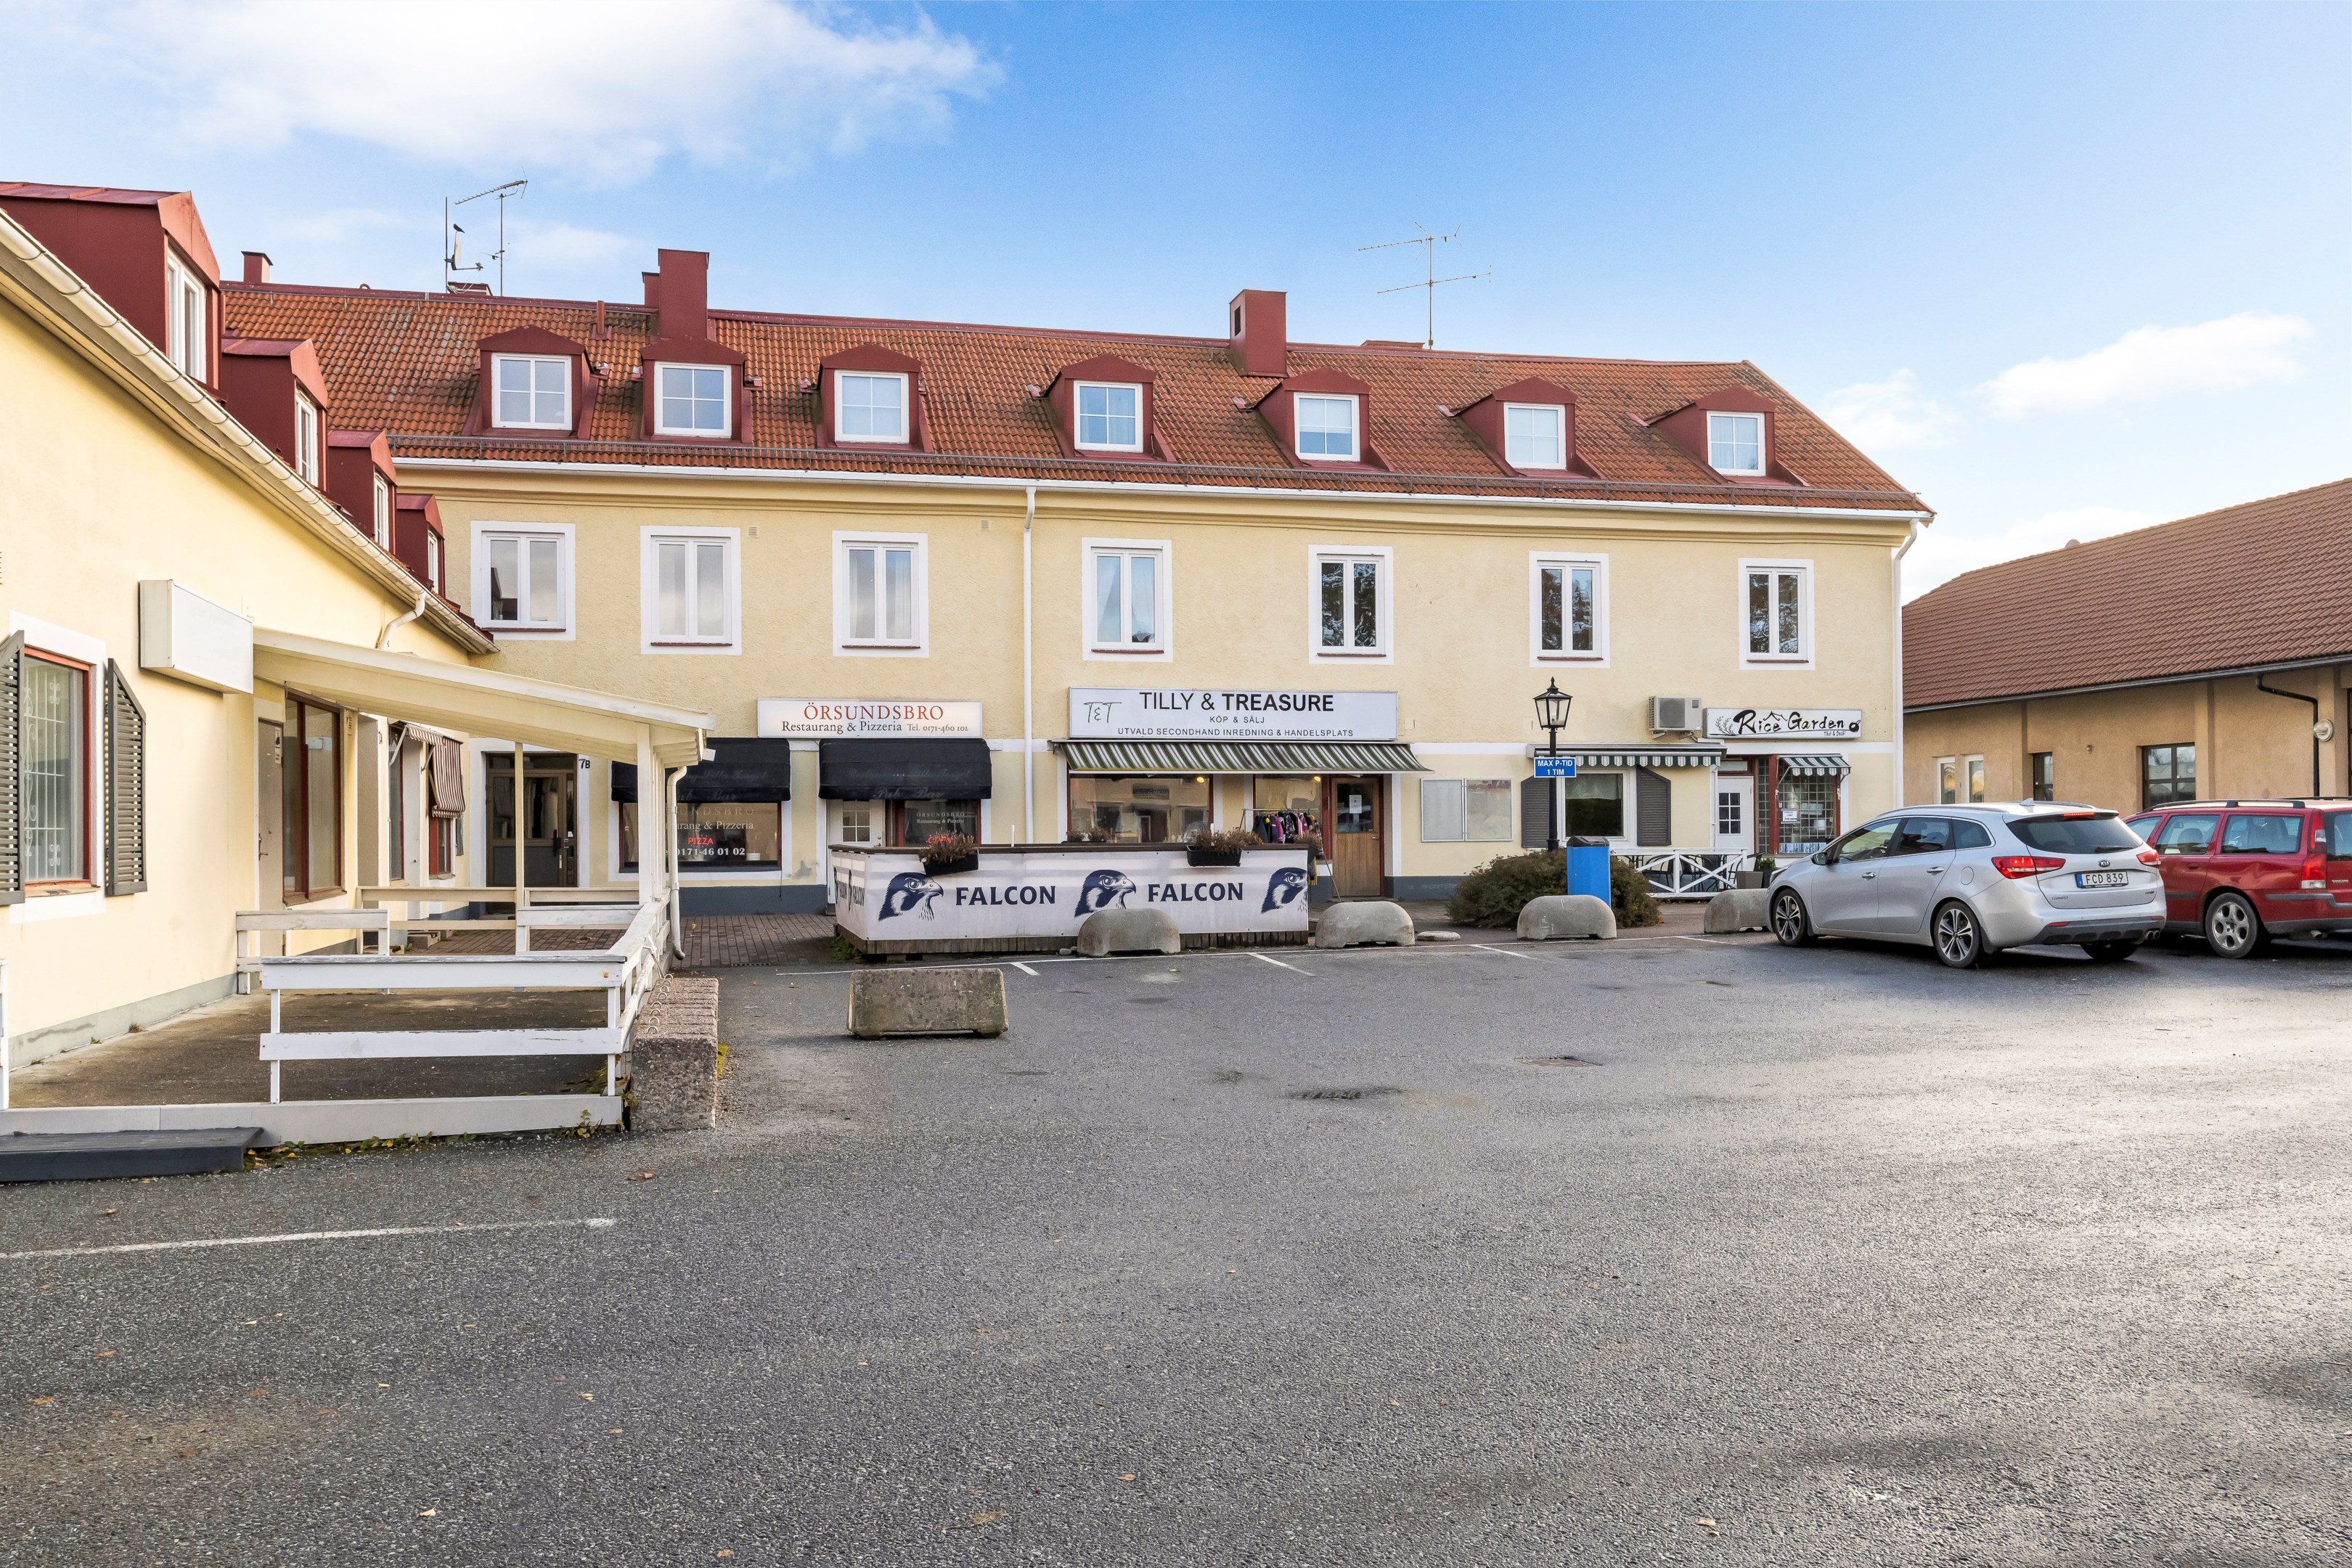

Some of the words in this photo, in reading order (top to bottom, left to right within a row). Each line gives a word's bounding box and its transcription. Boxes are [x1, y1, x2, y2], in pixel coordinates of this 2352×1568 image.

[1139, 692, 1194, 710] TILLY
[1201, 693, 1215, 711] &
[1222, 693, 1334, 711] TREASURE
[804, 702, 944, 720] ÖRSUNDSBRO
[782, 721, 843, 735] Restaurang
[846, 722, 857, 732] &
[859, 721, 902, 731] Pizzeria
[923, 724, 955, 734] 0171-460
[1733, 709, 1782, 735] Rice
[1787, 711, 1845, 730] Garden
[579, 759, 591, 769] 7B
[679, 807, 754, 816] UNDSBRO
[704, 820, 713, 830] &
[716, 820, 754, 830] Pizzeria
[2086, 874, 2104, 884] FCD
[2106, 873, 2123, 883] 839
[956, 885, 1056, 906] FALCON
[1148, 882, 1244, 902] FALCON
